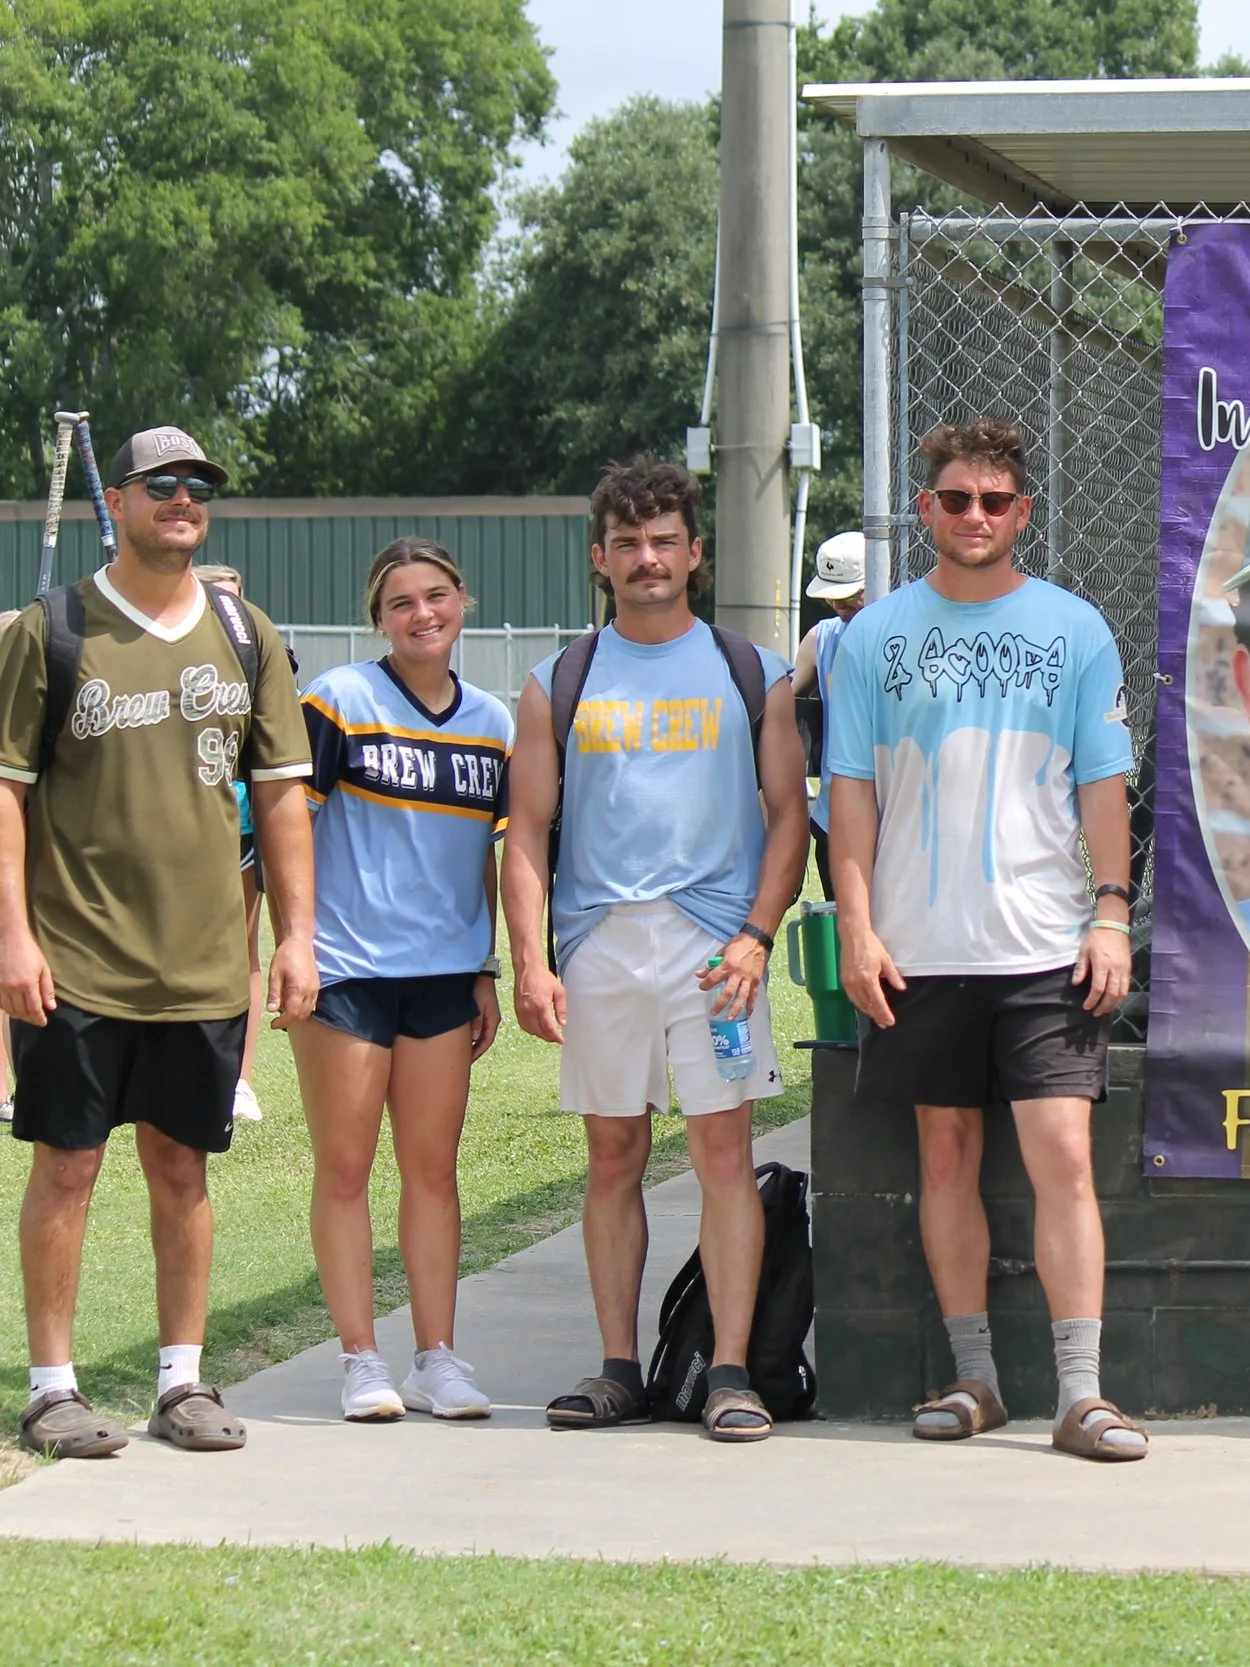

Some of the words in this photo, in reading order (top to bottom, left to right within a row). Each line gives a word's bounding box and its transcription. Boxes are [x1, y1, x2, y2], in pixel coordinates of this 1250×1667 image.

[72, 678, 170, 740] Brew
[574, 699, 645, 754] BREW
[651, 697, 723, 752] CREW
[362, 743, 438, 792] BREW
